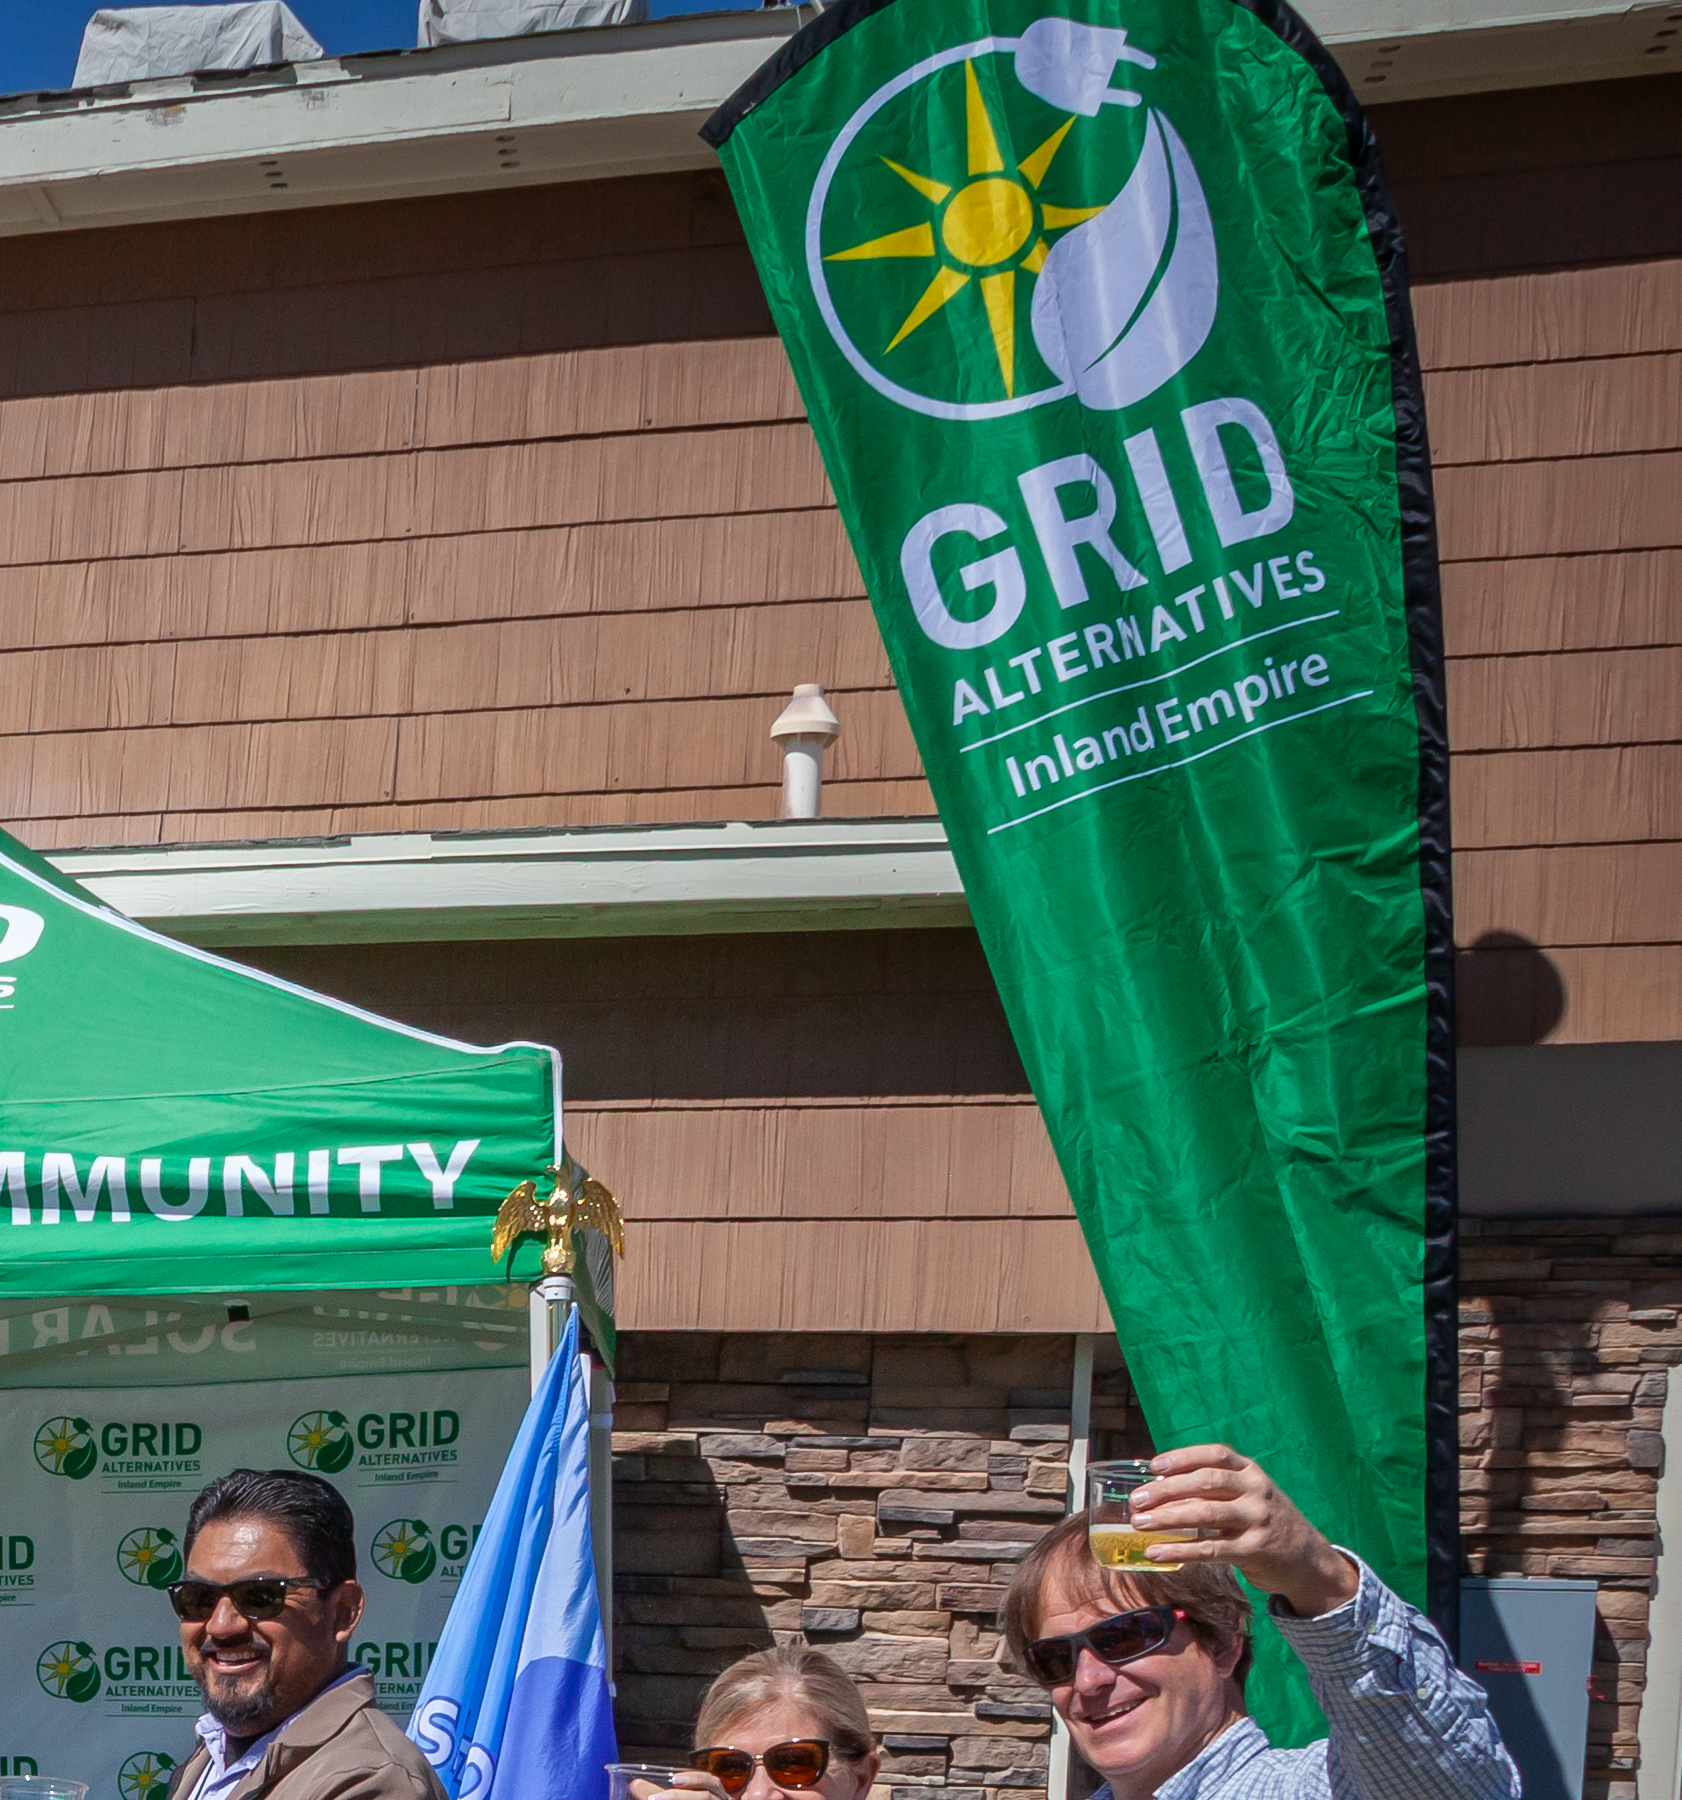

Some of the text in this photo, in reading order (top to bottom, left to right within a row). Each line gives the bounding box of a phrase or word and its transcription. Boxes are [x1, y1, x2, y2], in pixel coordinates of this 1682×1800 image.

[899, 397, 1295, 651] GRID
[951, 550, 1326, 726] ALTERNATIVES
[1005, 652, 1331, 798] Inland Empire
[357, 1410, 459, 1449] GRID
[101, 1422, 202, 1457] GRID
[101, 1460, 201, 1472] ALTERNATIVES
[358, 1450, 457, 1466] ALTERNATIVES
[374, 1470, 439, 1482] Inland Empire
[117, 1479, 182, 1490] Inland Empire
[105, 1685, 201, 1697] ALTERNATIVES
[121, 1704, 183, 1714] Inland Empire
